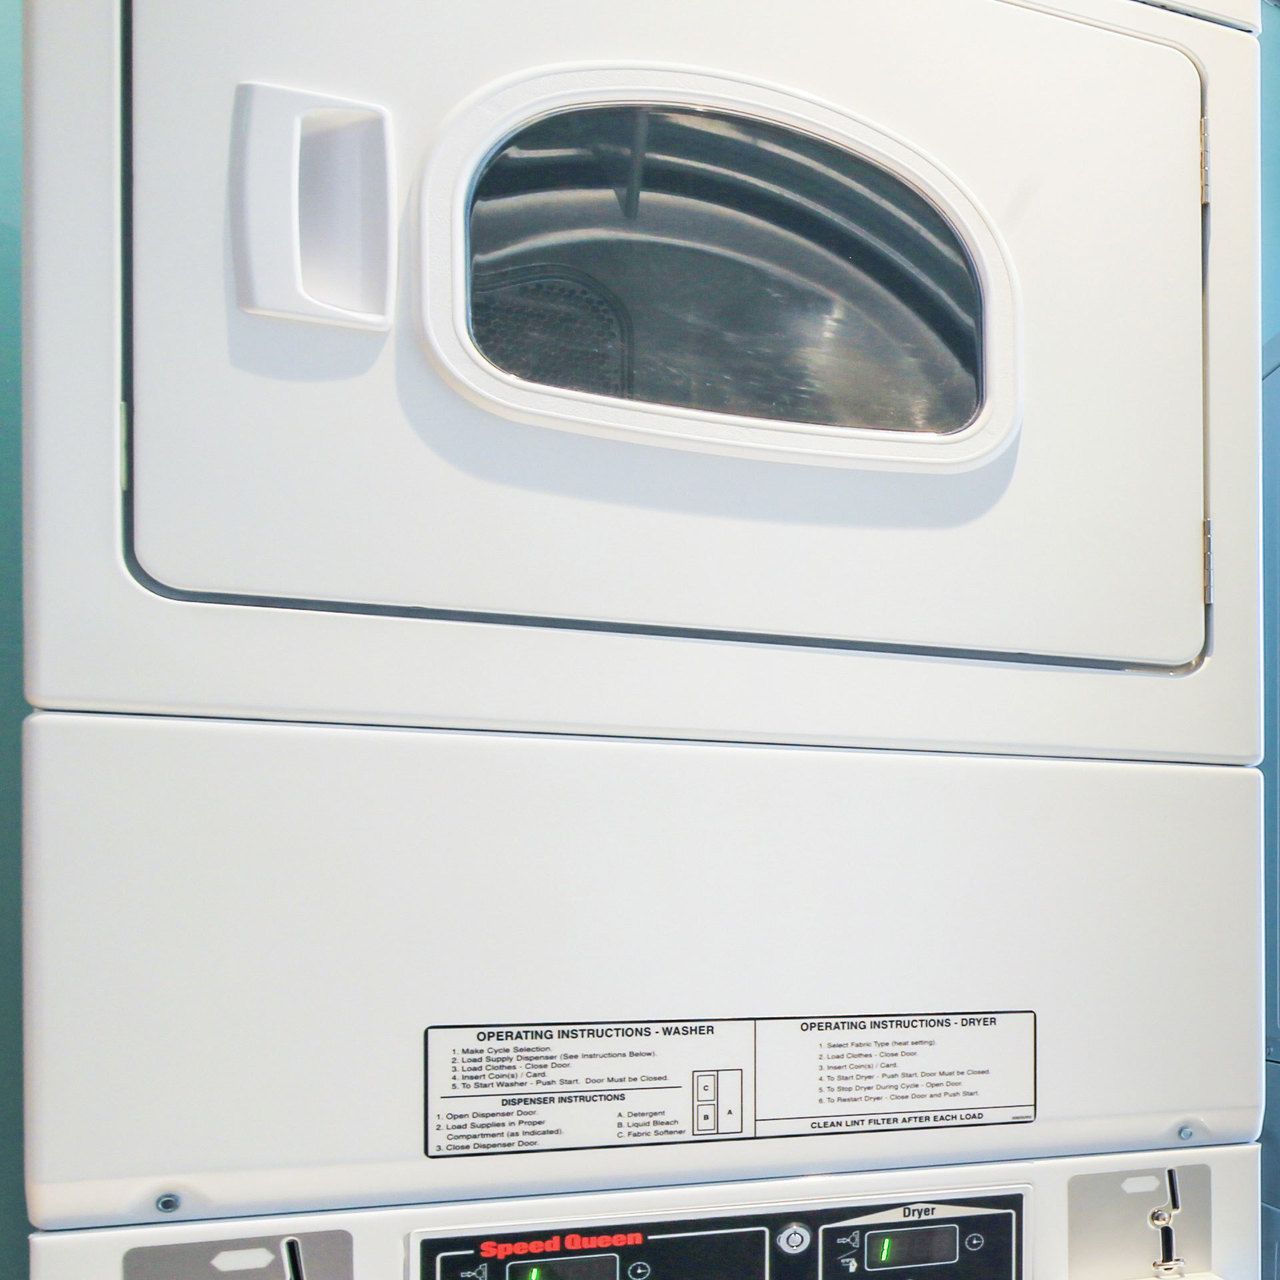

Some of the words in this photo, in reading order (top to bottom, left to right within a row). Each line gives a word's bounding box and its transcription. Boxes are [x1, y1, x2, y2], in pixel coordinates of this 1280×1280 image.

[800, 1020, 867, 1032] OPERATING
[870, 1018, 951, 1030] INSTRUCTIONS
[960, 1017, 996, 1027] DRYER
[476, 1029, 554, 1042] OPERATING
[557, 1026, 652, 1039] INSTRUCTIONS
[661, 1025, 714, 1036] WASHER
[461, 1047, 485, 1055] Make
[486, 1046, 510, 1054] Cycle
[512, 1045, 552, 1053] Selection.
[461, 1056, 483, 1064] Load
[485, 1055, 514, 1064] Supply
[516, 1053, 557, 1062] Dispenser
[559, 1052, 579, 1060] (See
[628, 1050, 656, 1058] Below).
[484, 1063, 517, 1071] Clothes
[524, 1062, 549, 1070] Close
[550, 1061, 571, 1069] Door.
[848, 1062, 874, 1070] Coin(s)
[461, 1073, 486, 1081] Insert
[487, 1071, 518, 1080] Coin(s)
[525, 1070, 547, 1078] Card.
[473, 1081, 494, 1089] Start
[495, 1080, 528, 1088] Washer
[535, 1078, 557, 1086] Push
[558, 1078, 581, 1086] Start.
[585, 1076, 605, 1084] Door
[639, 1074, 668, 1082] Closed.
[501, 1096, 555, 1107] DISPENSER
[557, 1093, 626, 1104] INSTRUCTIONS
[445, 1112, 470, 1121] Open
[471, 1110, 514, 1119] Dispenser
[516, 1108, 537, 1117] Door.
[627, 1110, 665, 1119] Detergent
[810, 1120, 843, 1129] CLEAN
[845, 1119, 865, 1127] LINT
[868, 1117, 899, 1126] FILTER
[900, 1115, 931, 1124] AFTER
[933, 1114, 957, 1122] EACH
[959, 1112, 984, 1121] LOAD
[470, 1120, 506, 1130] Supplies
[518, 1118, 545, 1127] Proper
[626, 1121, 651, 1129] Liquid
[446, 1131, 504, 1141] Compartment
[522, 1128, 563, 1137] Indicated).
[627, 1130, 651, 1138] Fabric
[653, 1128, 686, 1136] Softener
[445, 1143, 471, 1151] Close
[472, 1140, 516, 1150] Dispenser
[517, 1139, 539, 1147] Door.
[903, 1207, 936, 1219] Dryer
[480, 1236, 560, 1259] Speed
[565, 1232, 643, 1249] Queen
[881, 1238, 890, 1262] 1
